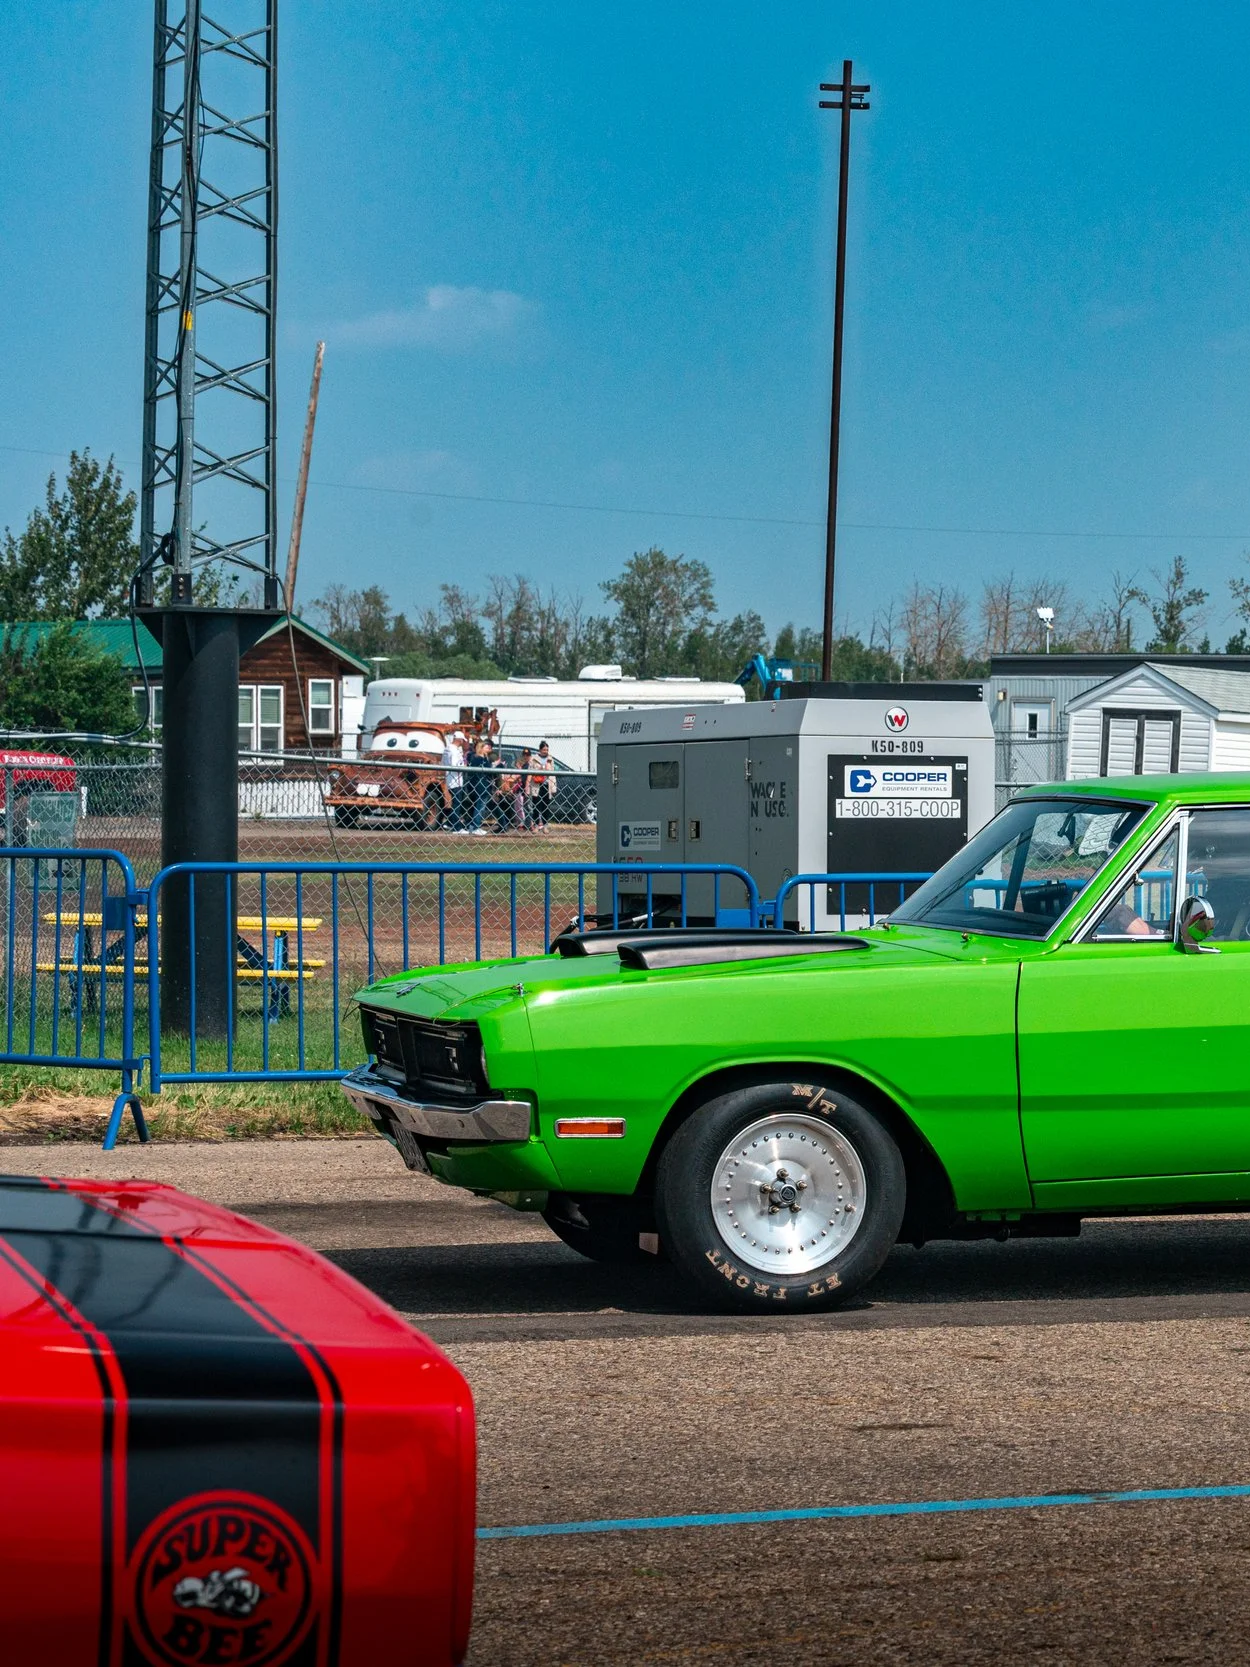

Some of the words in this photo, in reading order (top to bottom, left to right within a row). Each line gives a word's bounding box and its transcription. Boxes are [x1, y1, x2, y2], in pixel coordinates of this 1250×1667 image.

[871, 739, 924, 753] K50-809
[882, 772, 947, 782] COOPER
[837, 800, 959, 817] 1-800-315-COOP
[633, 827, 659, 836] COOPER
[791, 1085, 838, 1115] M/T
[705, 1249, 788, 1299] FRONT
[807, 1272, 842, 1297] ET
[152, 1515, 291, 1592] SUPER
[162, 1613, 272, 1666] BEE
